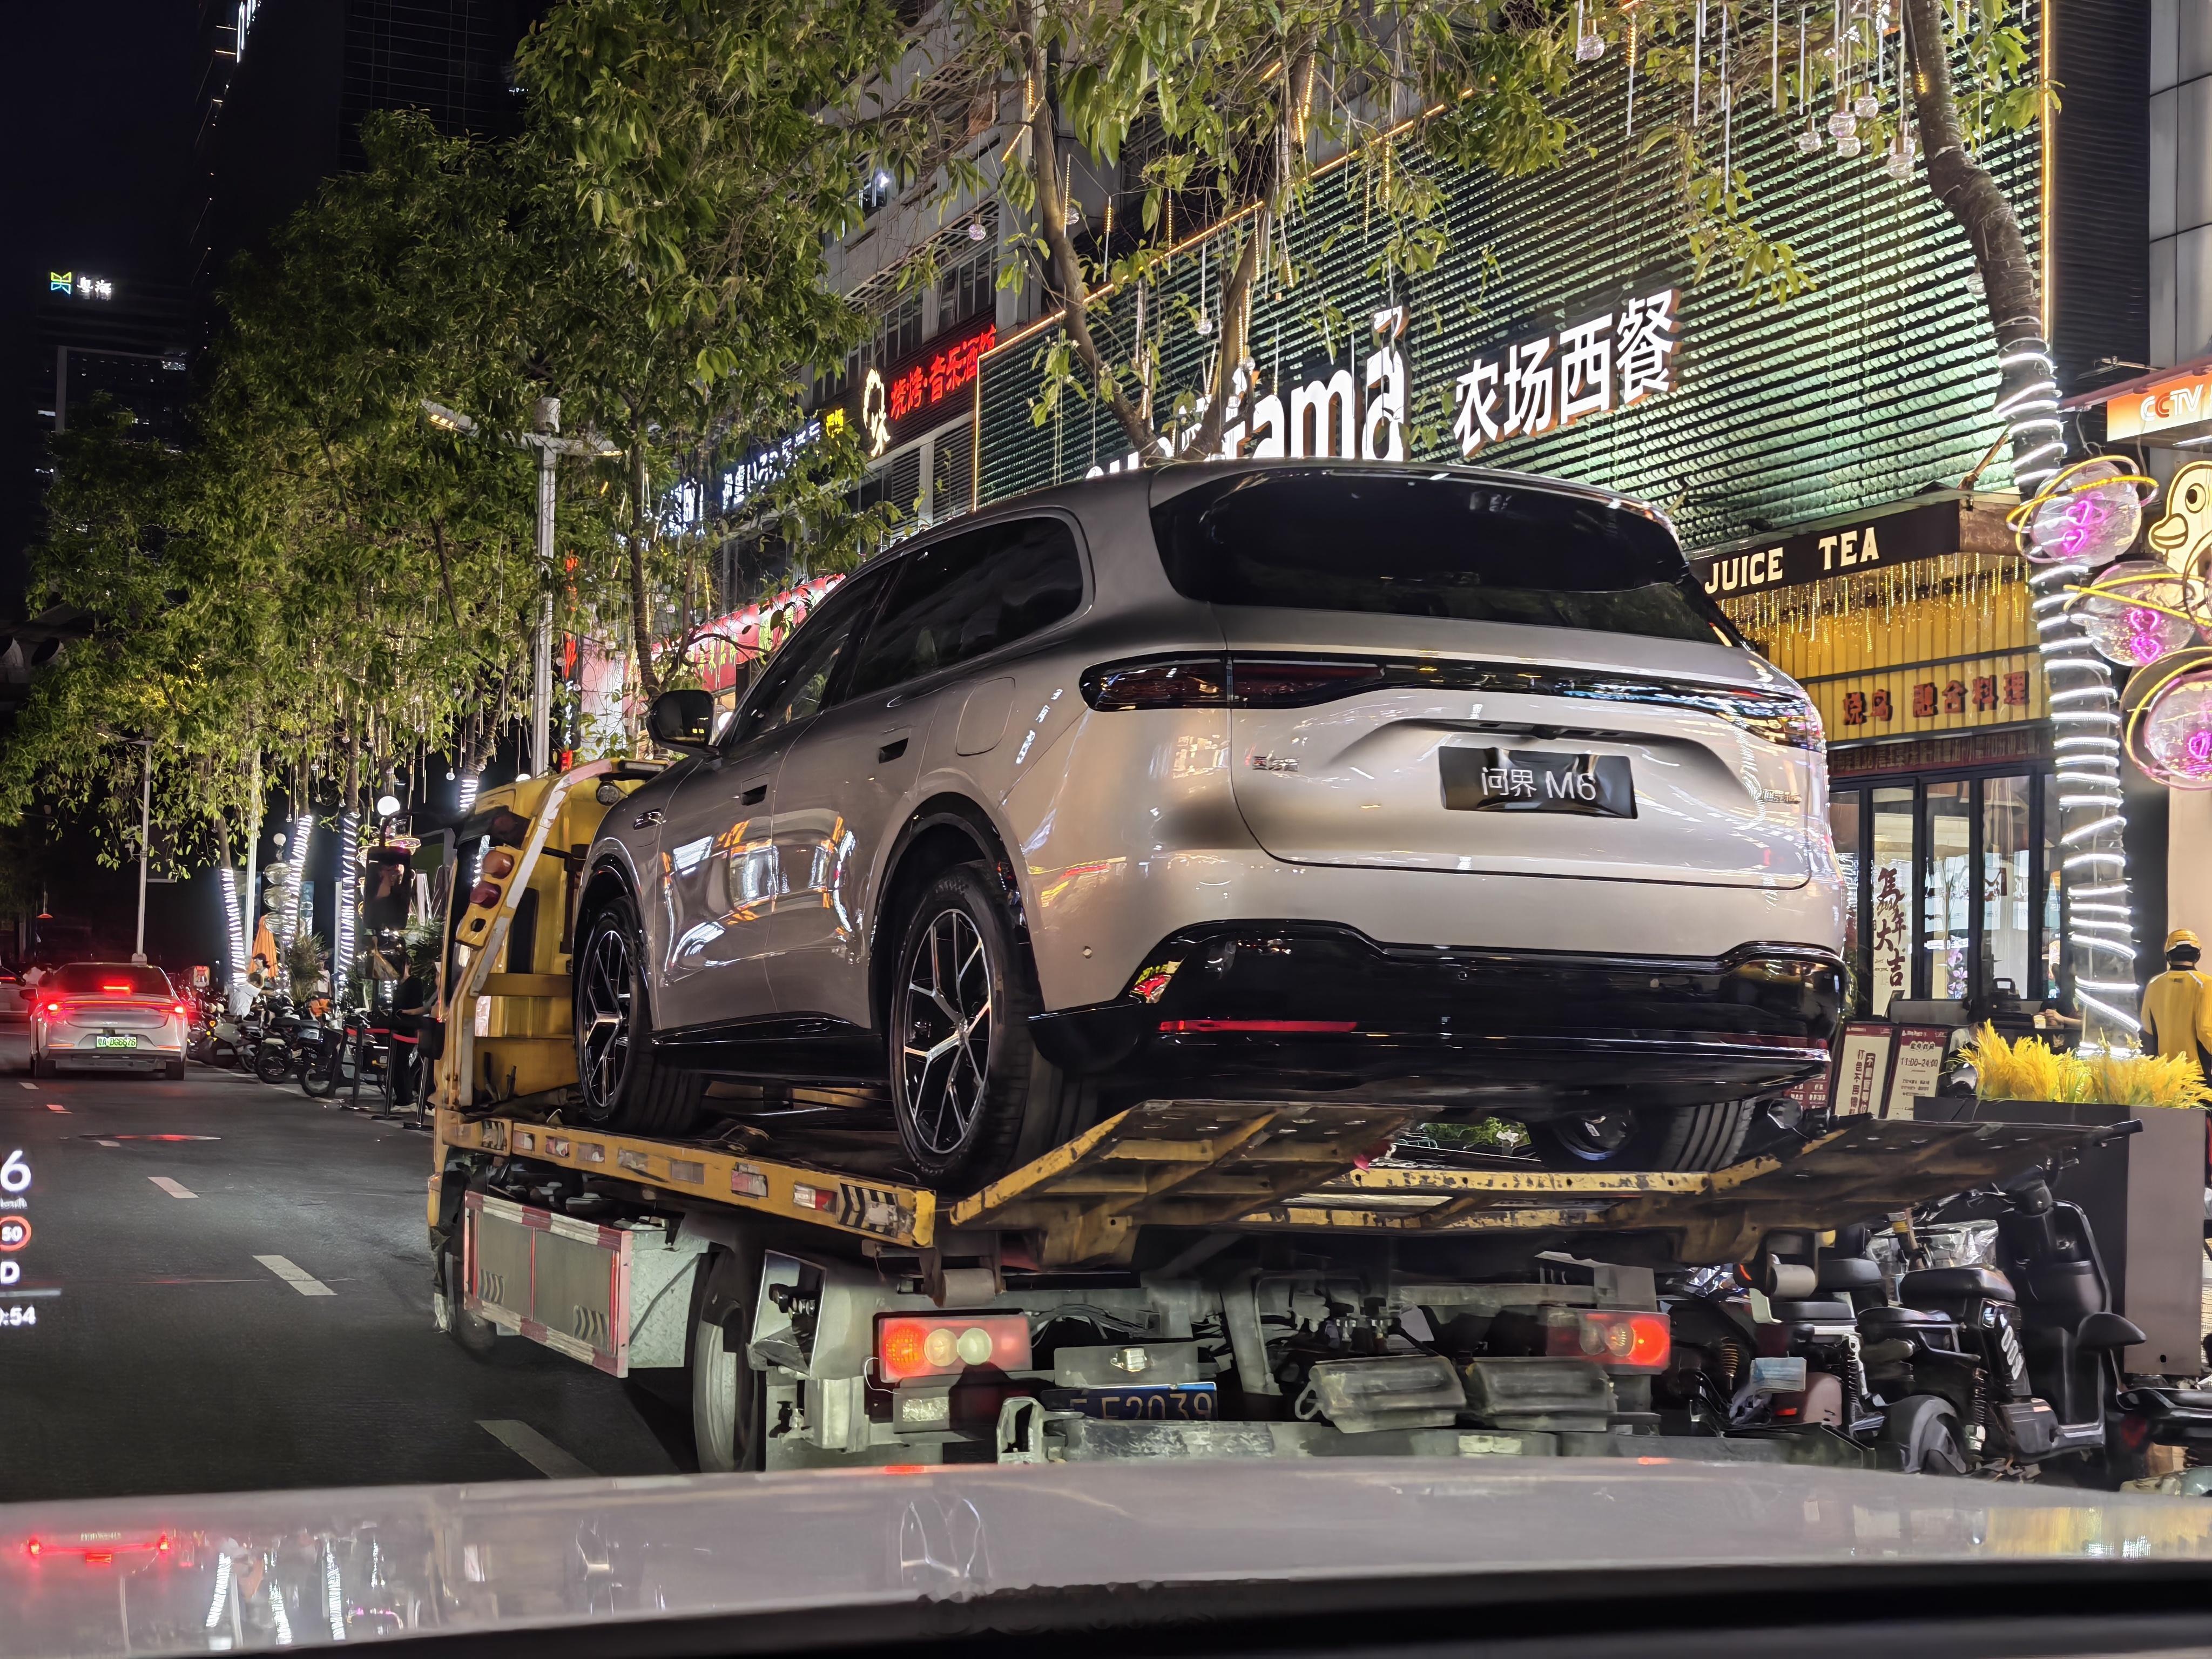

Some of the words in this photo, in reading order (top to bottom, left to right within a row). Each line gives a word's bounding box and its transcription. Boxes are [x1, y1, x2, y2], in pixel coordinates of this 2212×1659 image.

[1453, 289, 1674, 457] 农场西餐
[2140, 384, 2204, 422] CCTV
[1704, 547, 1783, 594] JUICE
[1818, 527, 1880, 570] TEA
[1481, 767, 1537, 798] 问界
[1545, 771, 1596, 800] M6
[1, 1261, 20, 1284] D
